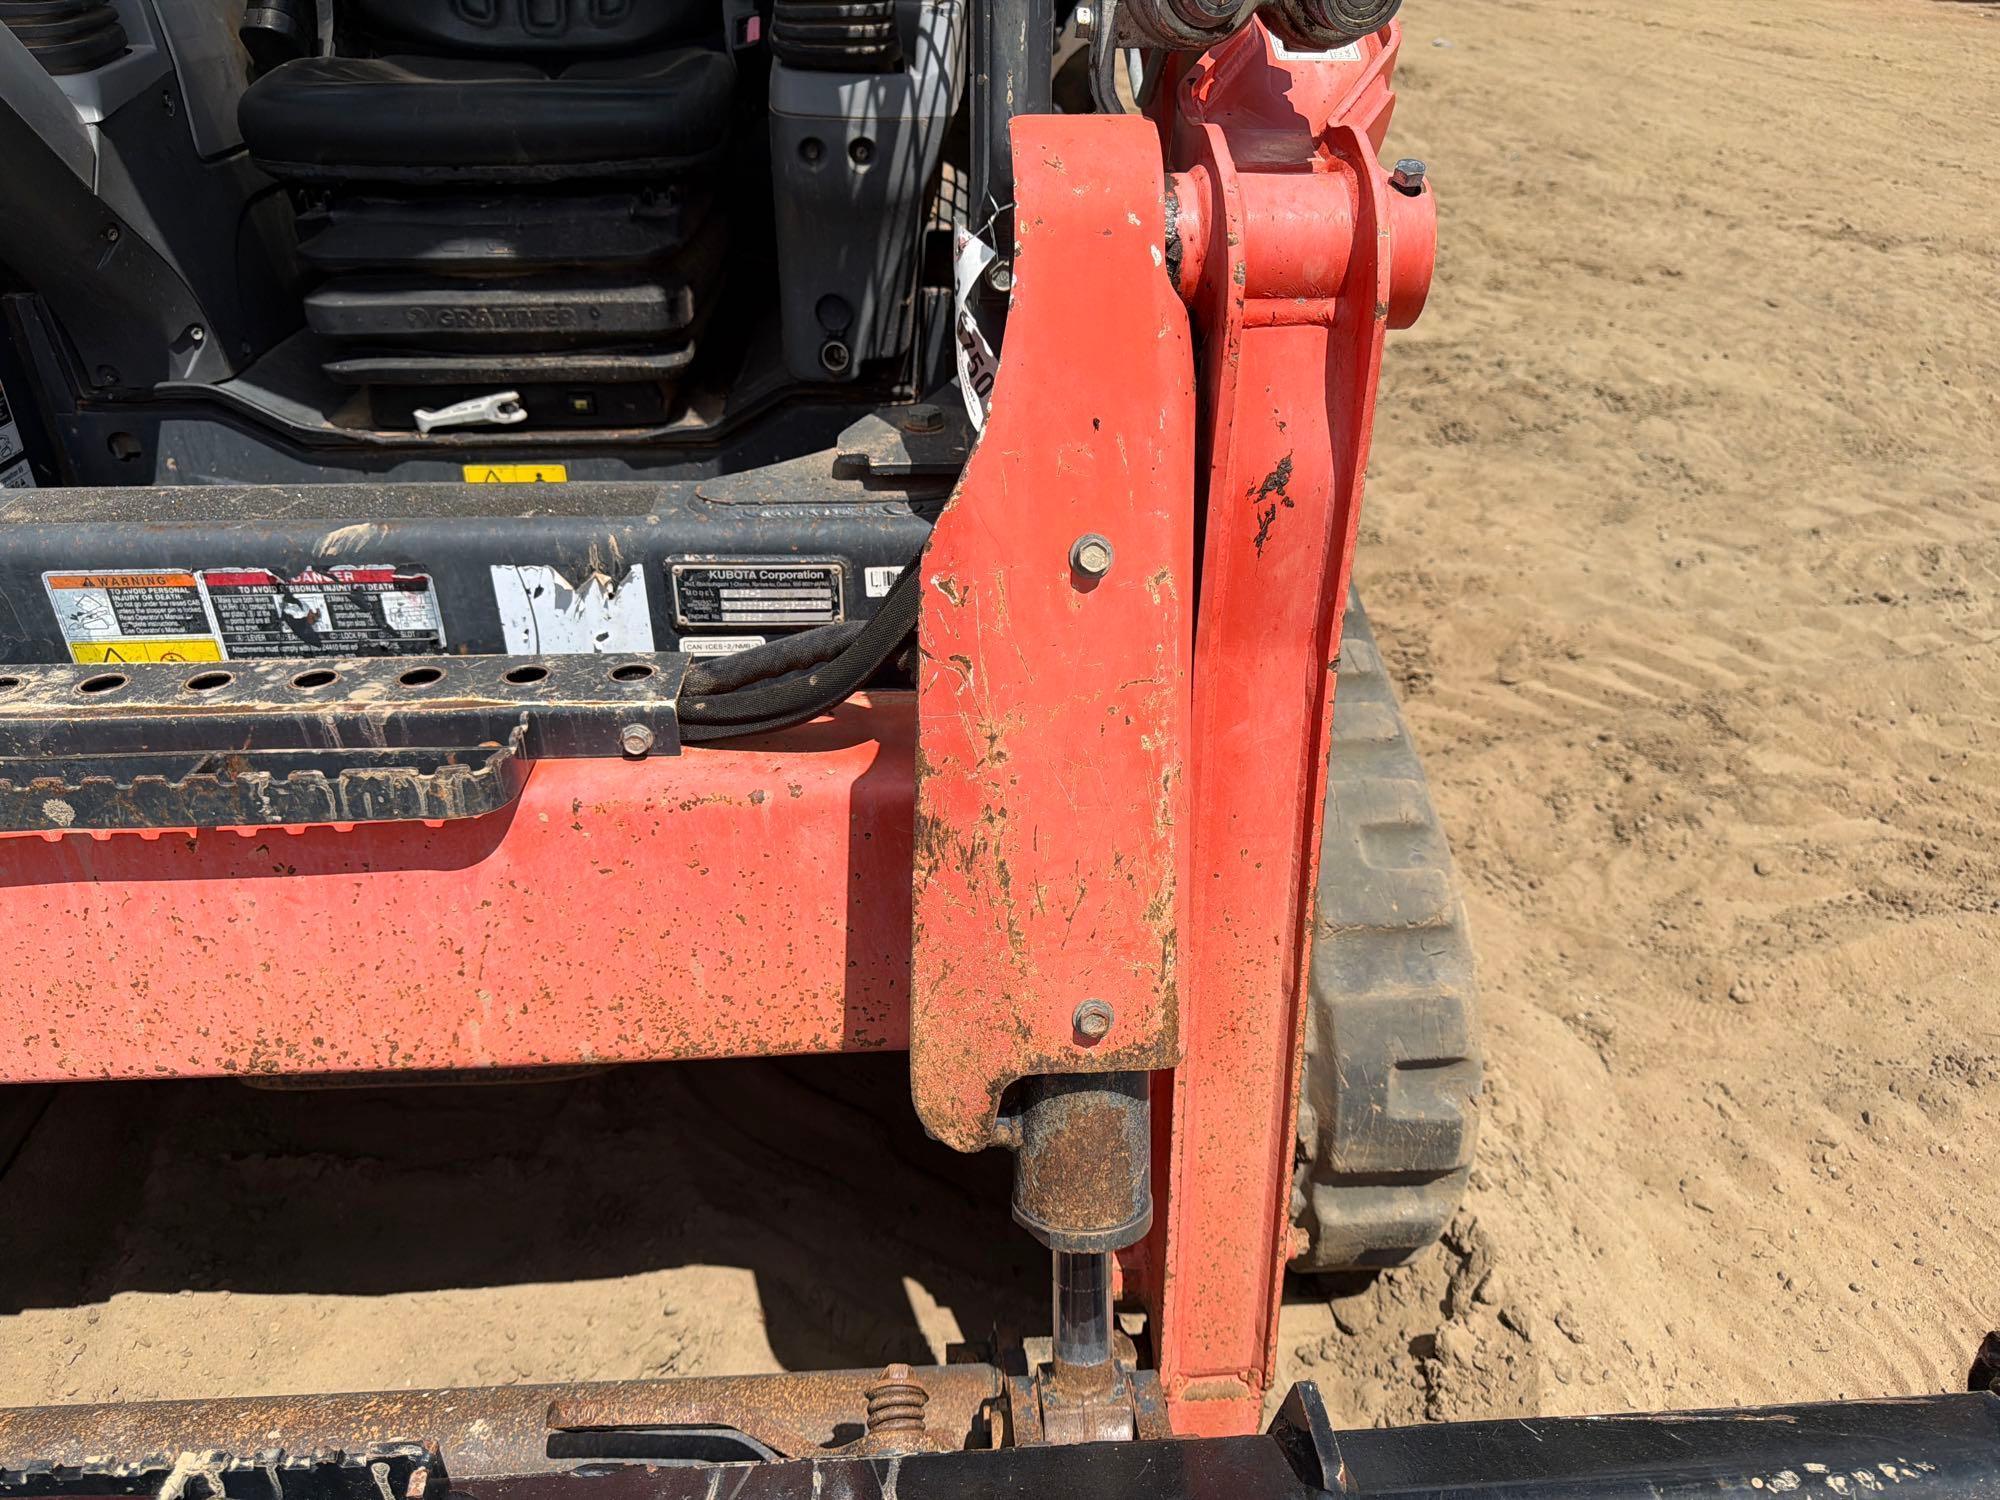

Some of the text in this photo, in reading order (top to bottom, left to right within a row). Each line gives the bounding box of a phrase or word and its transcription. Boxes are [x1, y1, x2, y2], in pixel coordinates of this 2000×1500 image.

[709, 569, 824, 581] KUBOTA Corporation
[97, 576, 166, 587] WARNING
[239, 586, 250, 594] TO
[252, 586, 277, 594] AVOID
